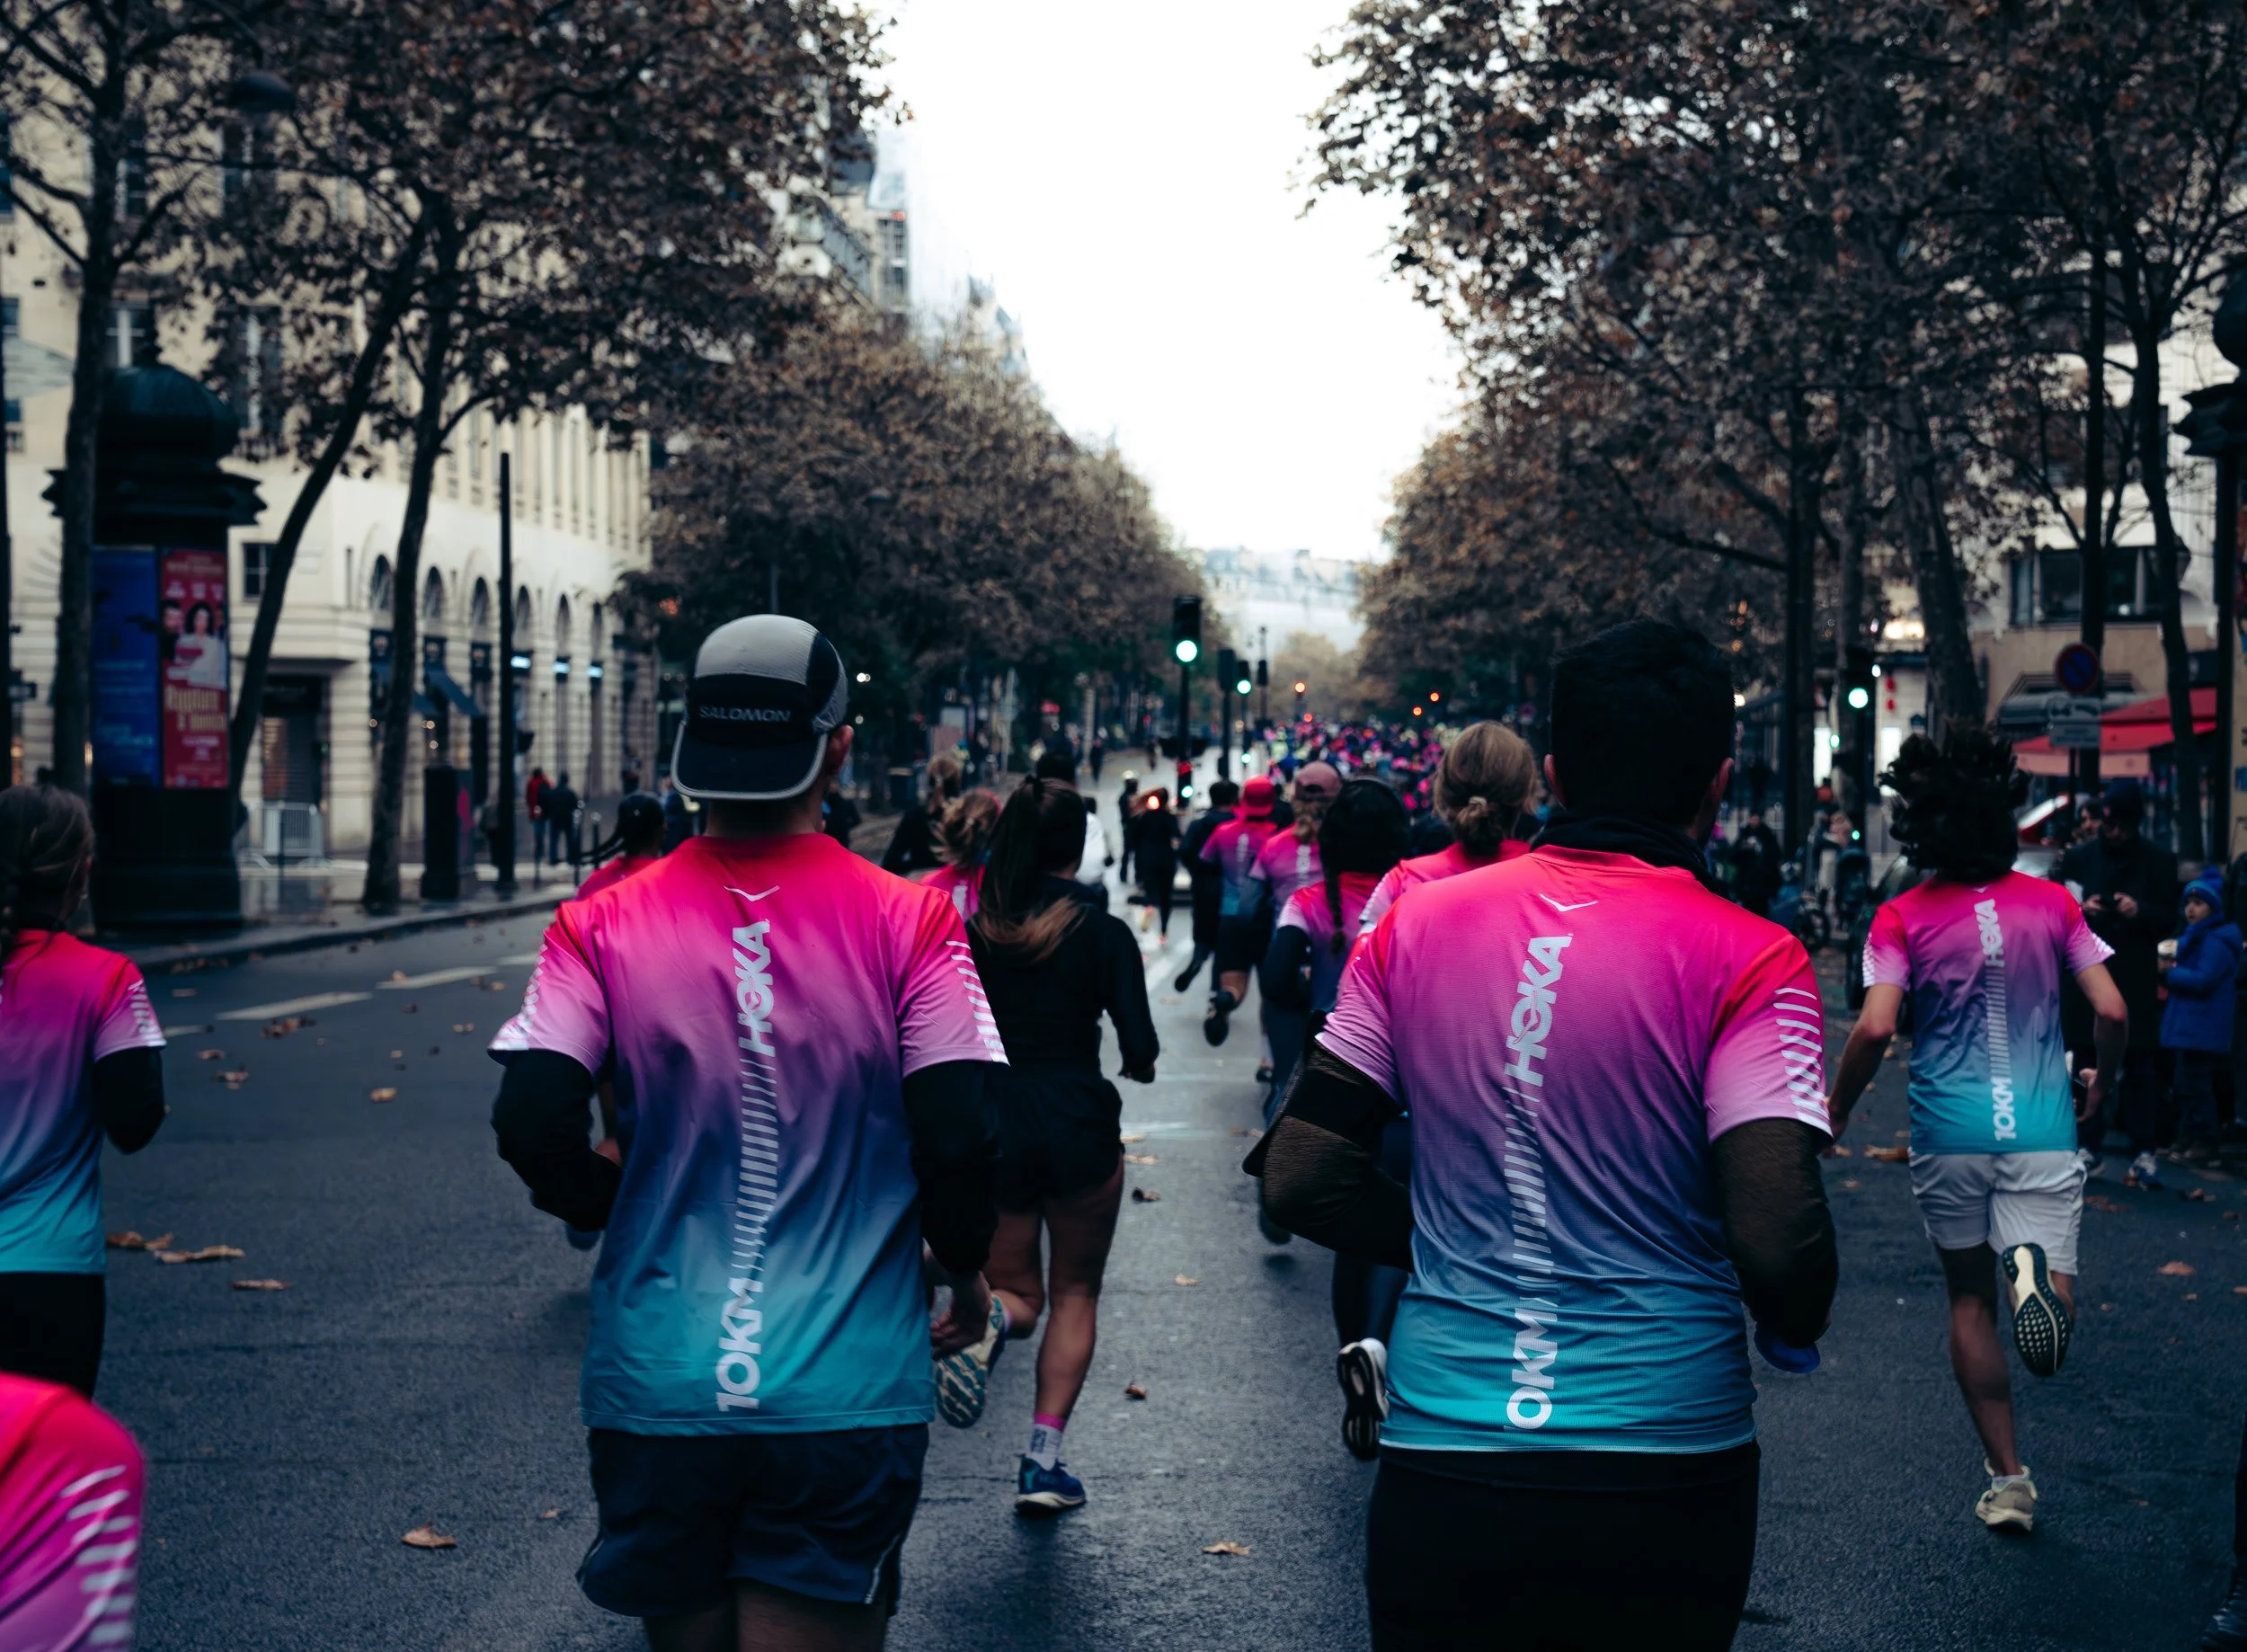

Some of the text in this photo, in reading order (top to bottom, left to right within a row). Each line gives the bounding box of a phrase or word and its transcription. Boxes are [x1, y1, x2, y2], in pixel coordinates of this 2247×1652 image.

[698, 706, 791, 722] SALOMON
[733, 919, 776, 1057] HOKA
[1975, 899, 2004, 968] HOKA
[1504, 933, 1573, 1088] HOKA
[1991, 1079, 2017, 1141] 10KM
[715, 1277, 763, 1412] 10KM
[1504, 1307, 1558, 1432] 0KM
